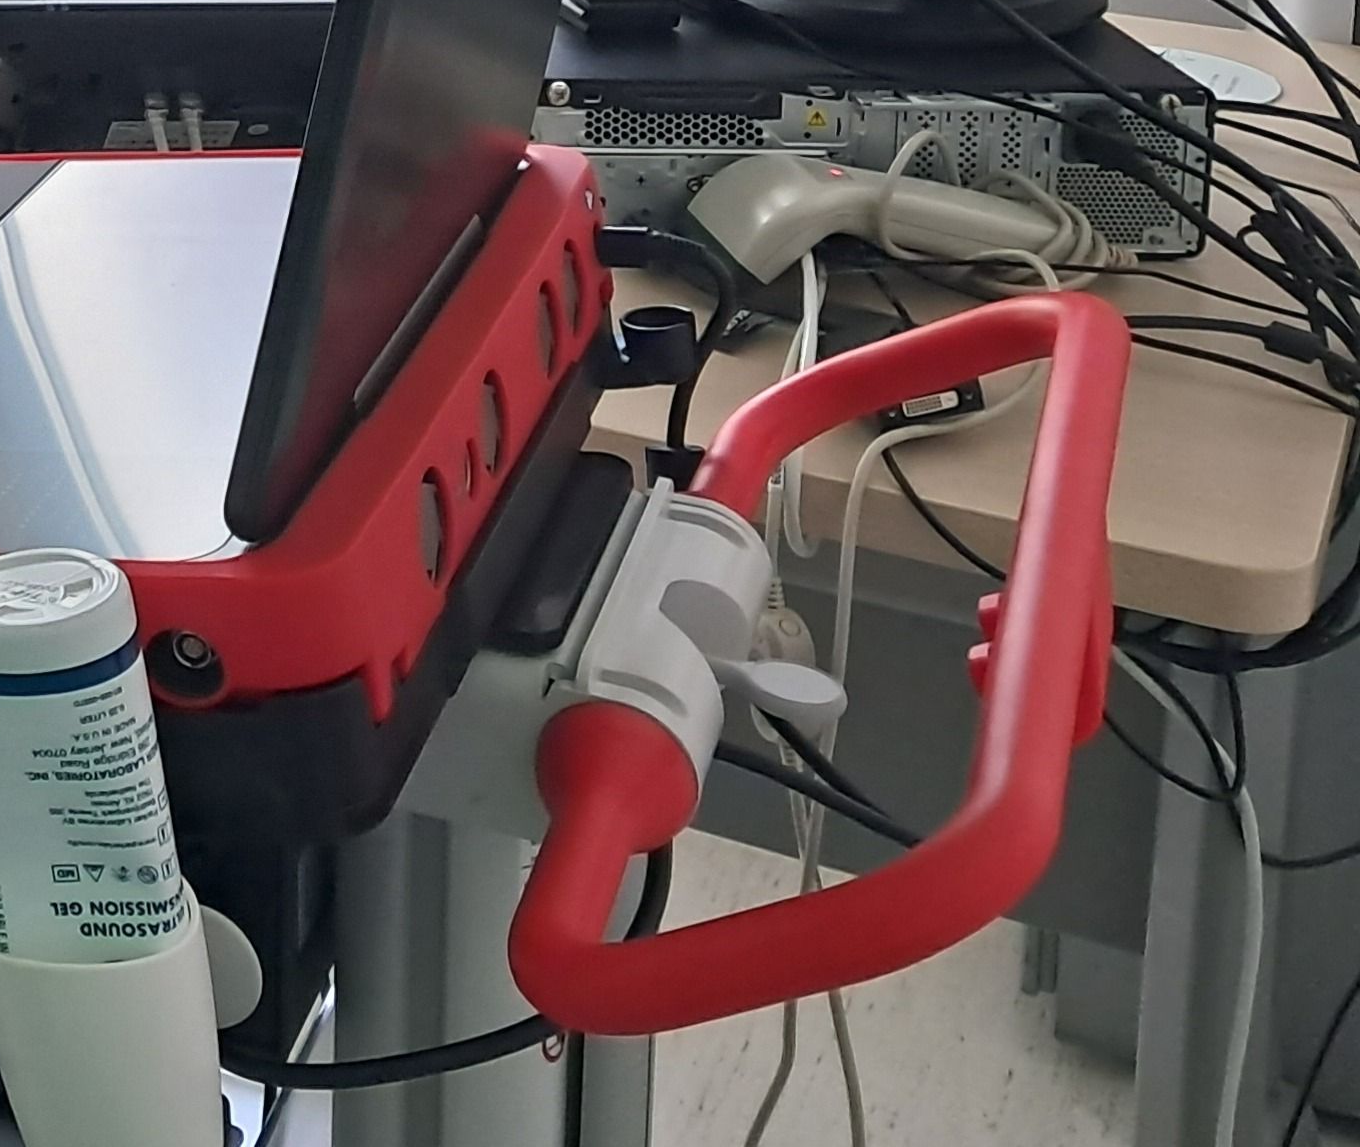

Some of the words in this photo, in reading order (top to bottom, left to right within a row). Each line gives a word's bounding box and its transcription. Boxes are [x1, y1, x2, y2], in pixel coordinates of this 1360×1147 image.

[109, 734, 133, 751] New
[69, 743, 108, 758] Jersey
[59, 758, 91, 770] Road
[56, 868, 77, 879] MD
[49, 901, 83, 918] GEL
